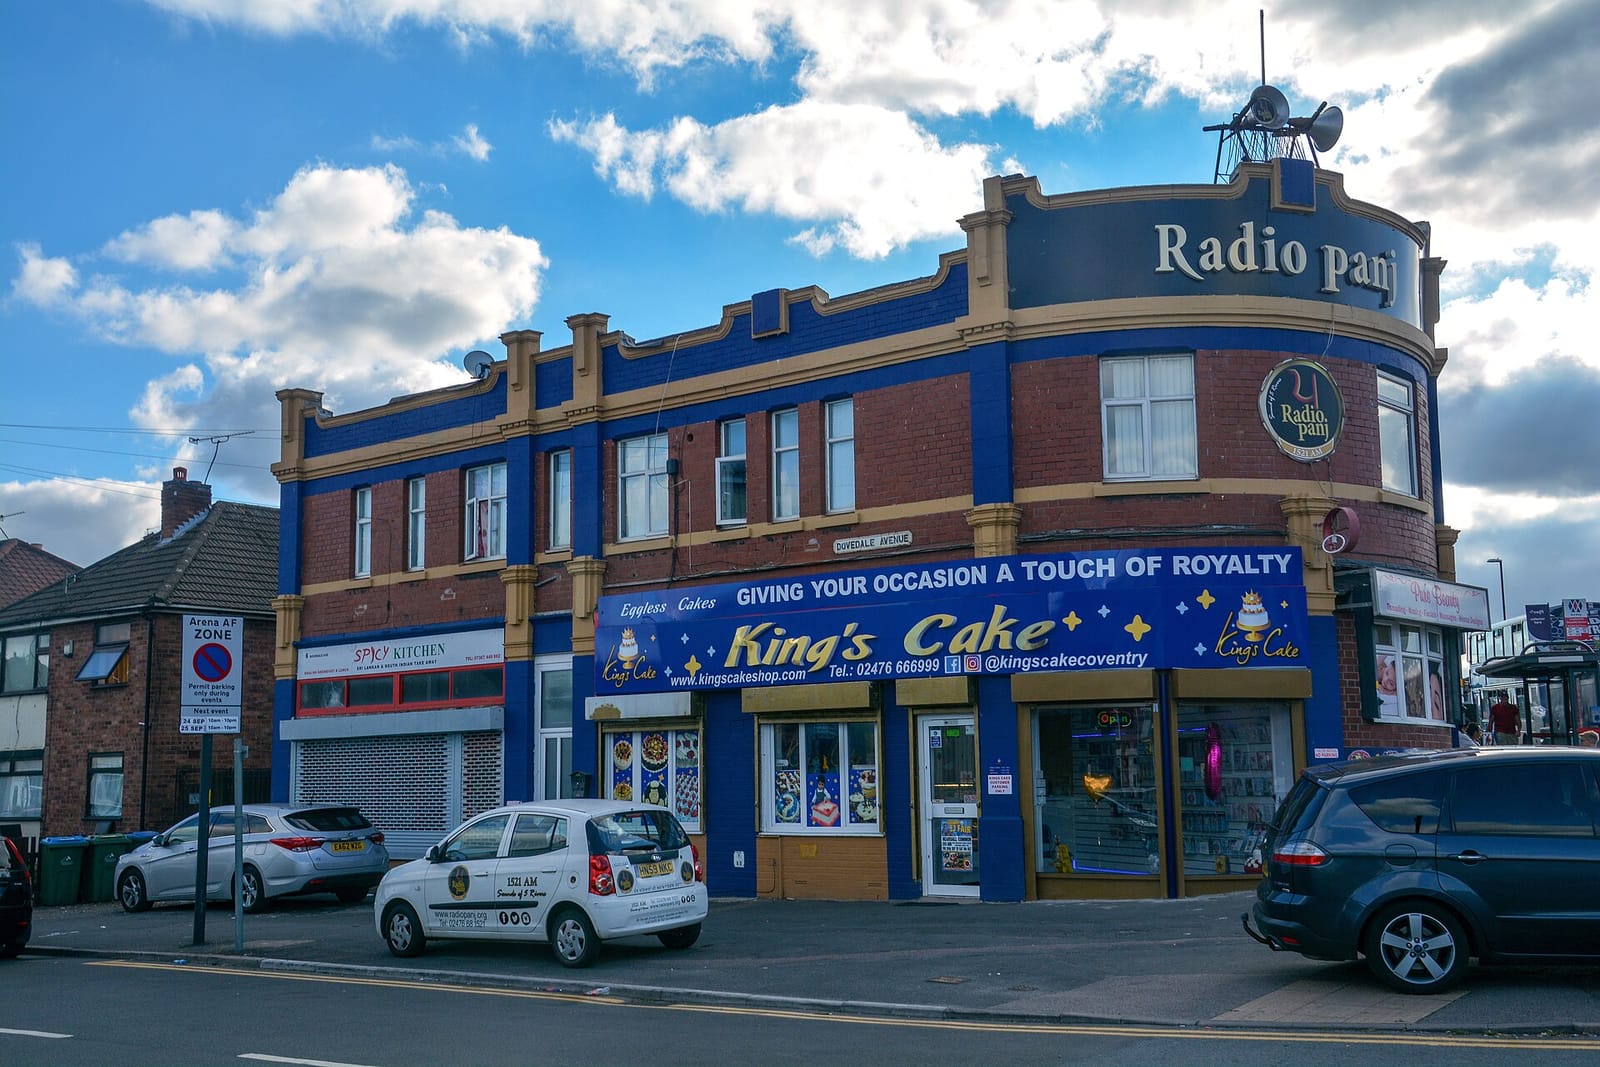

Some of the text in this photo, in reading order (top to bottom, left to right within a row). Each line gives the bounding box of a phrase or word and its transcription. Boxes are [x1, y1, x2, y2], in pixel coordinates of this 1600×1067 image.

[1154, 221, 1397, 308] Radio panj
[1281, 404, 1324, 425] Radio
[1297, 418, 1328, 441] panj
[1292, 448, 1309, 456] 1521
[836, 534, 909, 551] DOVEDALE AVENUE
[737, 553, 1293, 606] GIVING YOUR OCCASION A TOUCH OF ROYALTY
[620, 596, 717, 619] Eggless Cakes
[1432, 585, 1460, 613] Beauty
[189, 617, 219, 627] Arena
[194, 629, 232, 640] ZONE
[723, 605, 1057, 673] King's Cake
[1214, 611, 1300, 664] King's Cake
[353, 643, 446, 664] SPICY KITCHEN
[985, 651, 1148, 672] @kingscakecoventry
[602, 644, 657, 688] King's Cake
[829, 659, 940, 678] Tel.: 02476 666999
[670, 669, 807, 688] www.kingscakeshop.com
[640, 862, 673, 875] HN59 NKC
[507, 876, 538, 886] 1521 AM
[497, 889, 546, 899] Sounds of 5 Rivers
[435, 911, 487, 921] www.radiopanj.org
